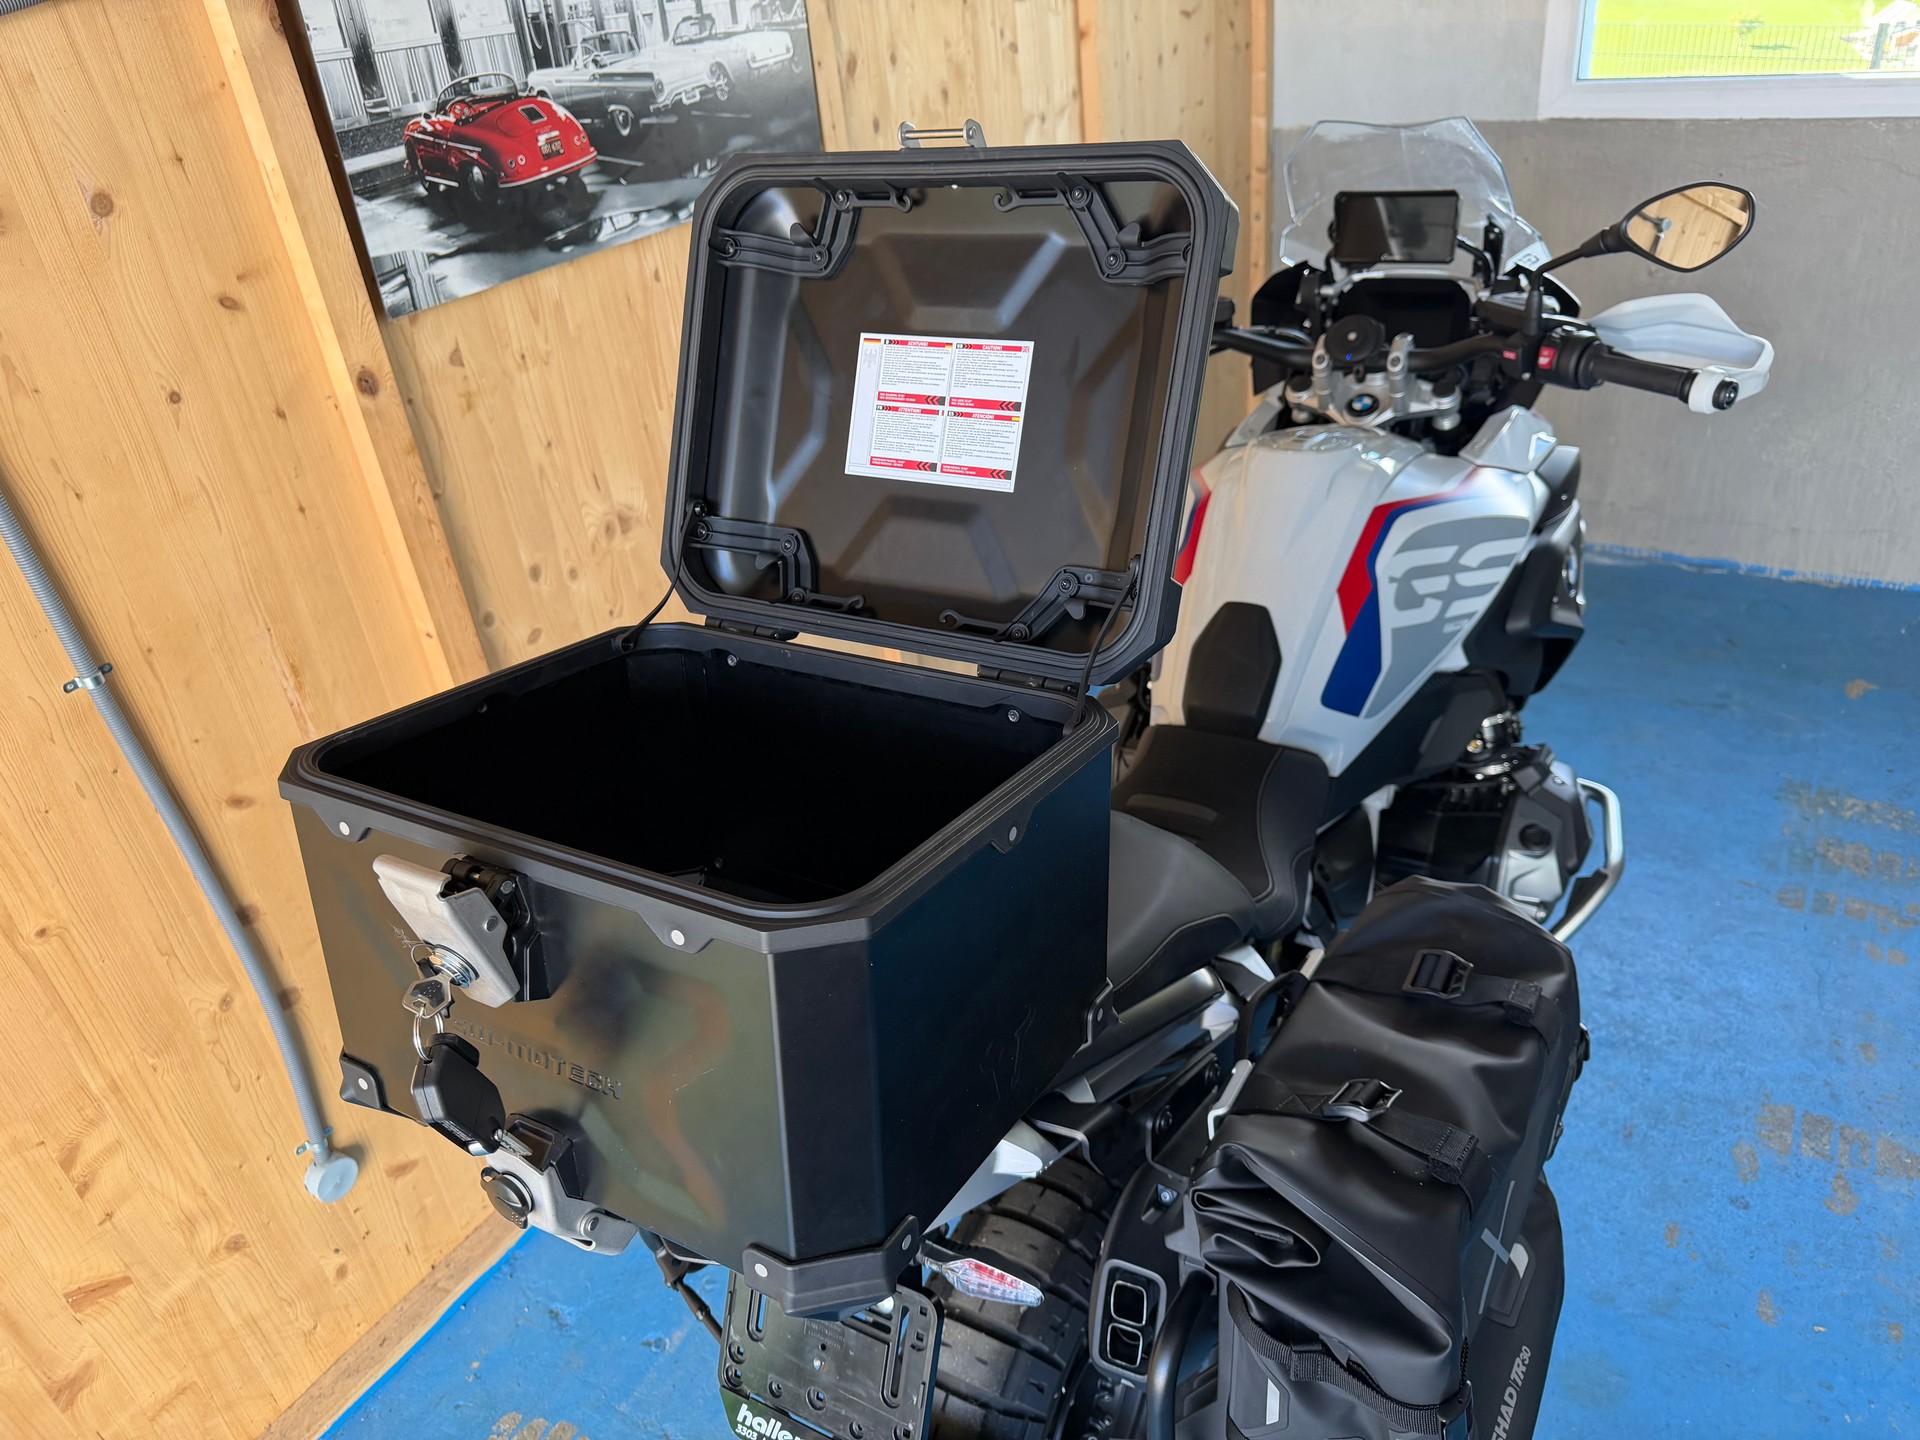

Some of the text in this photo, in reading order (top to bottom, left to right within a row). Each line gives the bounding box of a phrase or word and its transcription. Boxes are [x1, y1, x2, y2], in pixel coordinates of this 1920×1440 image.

[452, 1018, 624, 1100] SW-MOTECH
[735, 1424, 758, 1440] 3303
[737, 1403, 802, 1440] halle
[1491, 1386, 1518, 1440] HAD
